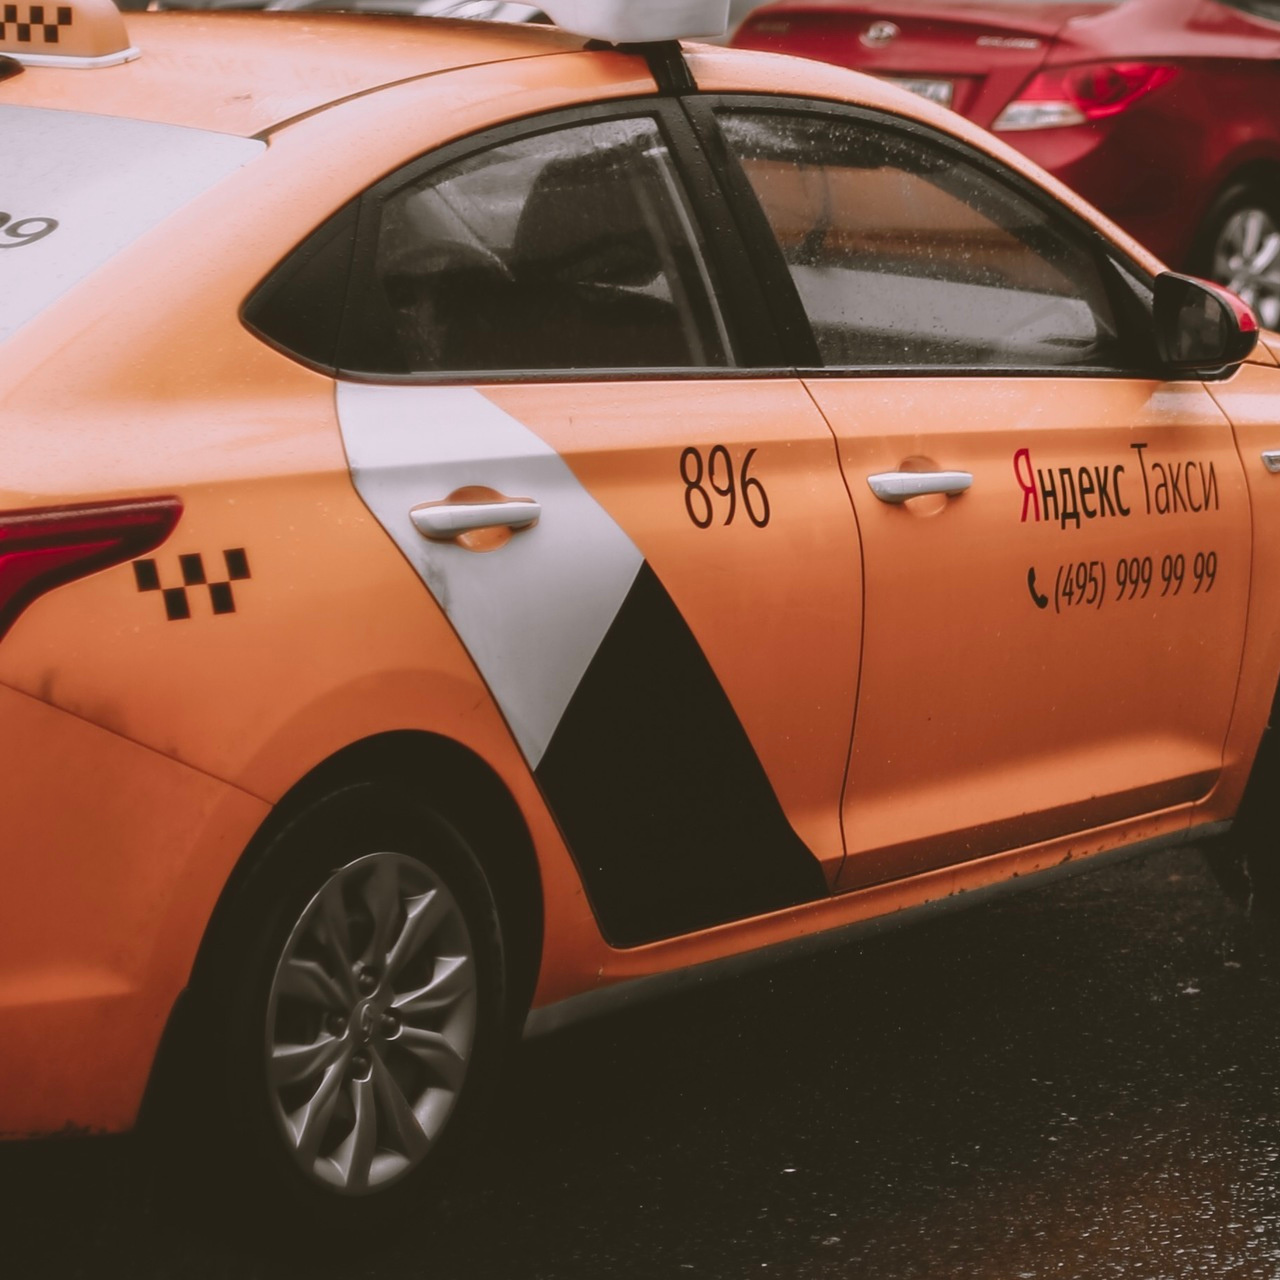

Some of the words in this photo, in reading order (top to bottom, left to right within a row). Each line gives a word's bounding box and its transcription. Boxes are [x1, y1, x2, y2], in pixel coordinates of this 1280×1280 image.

[680, 444, 770, 529] 896
[1013, 448, 1130, 530] Яндекс
[1130, 443, 1219, 515] Такси
[1055, 561, 1106, 614] (495)
[1116, 556, 1153, 601] 999
[1161, 554, 1185, 597] 99
[1193, 551, 1217, 593] 99
